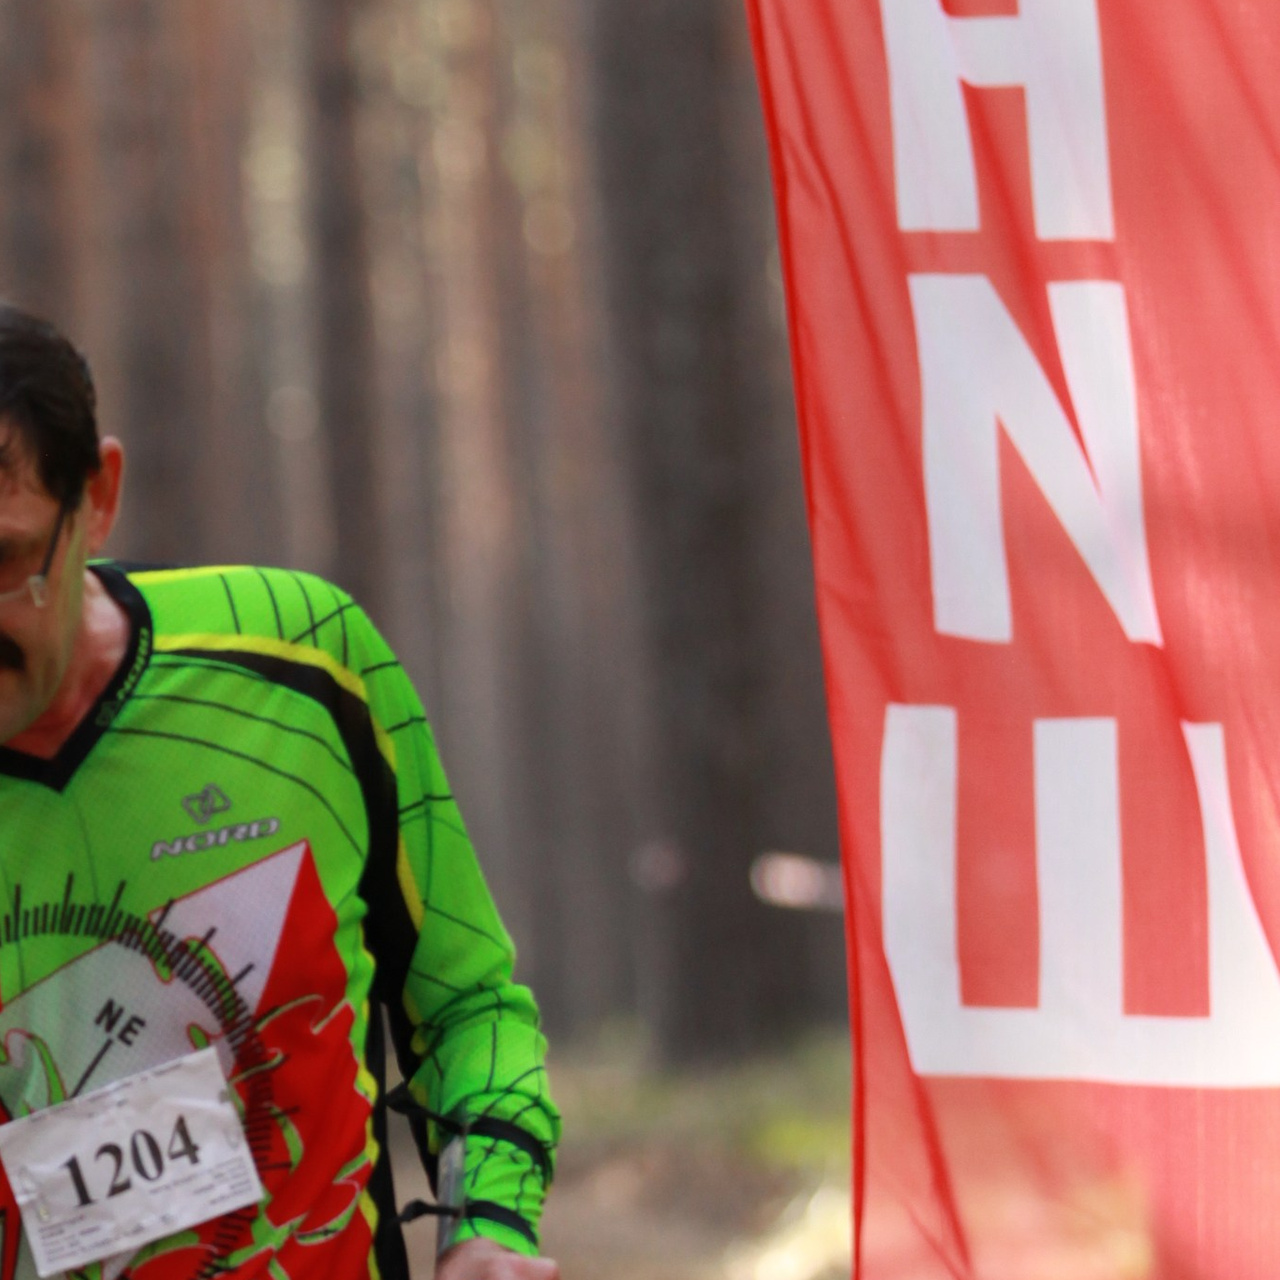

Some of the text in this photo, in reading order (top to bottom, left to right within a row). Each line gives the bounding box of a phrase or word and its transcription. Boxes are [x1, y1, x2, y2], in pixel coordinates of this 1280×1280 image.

[150, 817, 280, 862] NORD
[93, 998, 146, 1048] NE
[60, 1114, 201, 1208] 1204
